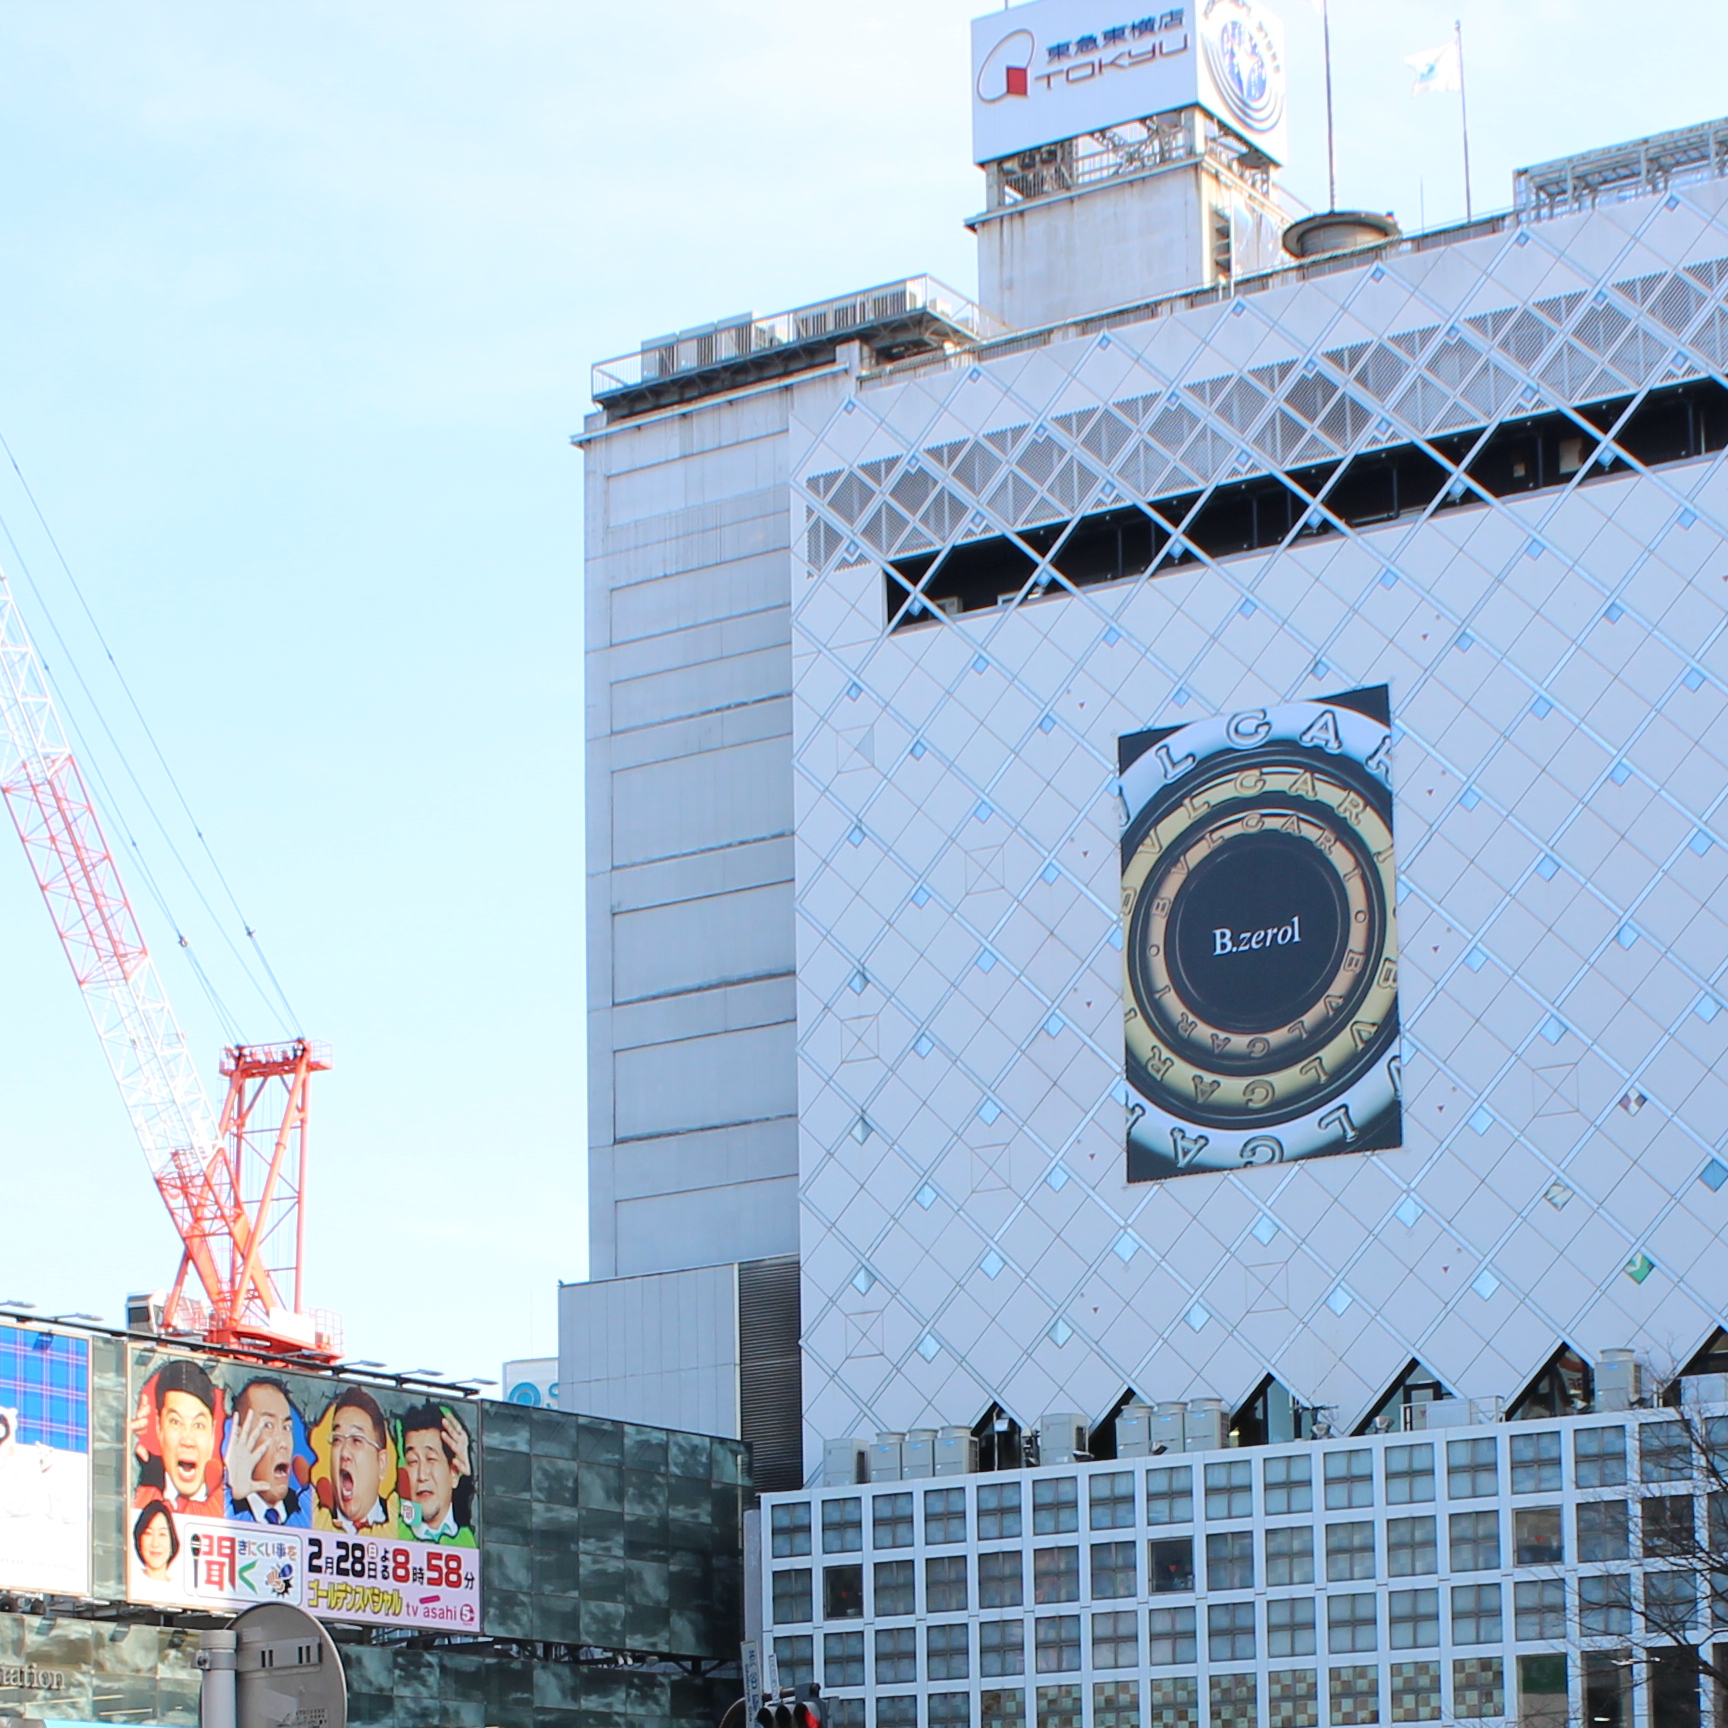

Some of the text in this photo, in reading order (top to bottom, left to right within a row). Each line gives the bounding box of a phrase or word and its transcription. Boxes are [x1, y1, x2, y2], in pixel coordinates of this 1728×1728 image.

[1034, 33, 1189, 90] TOKYU
[1046, 9, 1185, 65] 東急東横店
[405, 1602, 419, 1618] tv
[422, 1603, 458, 1621] asahi
